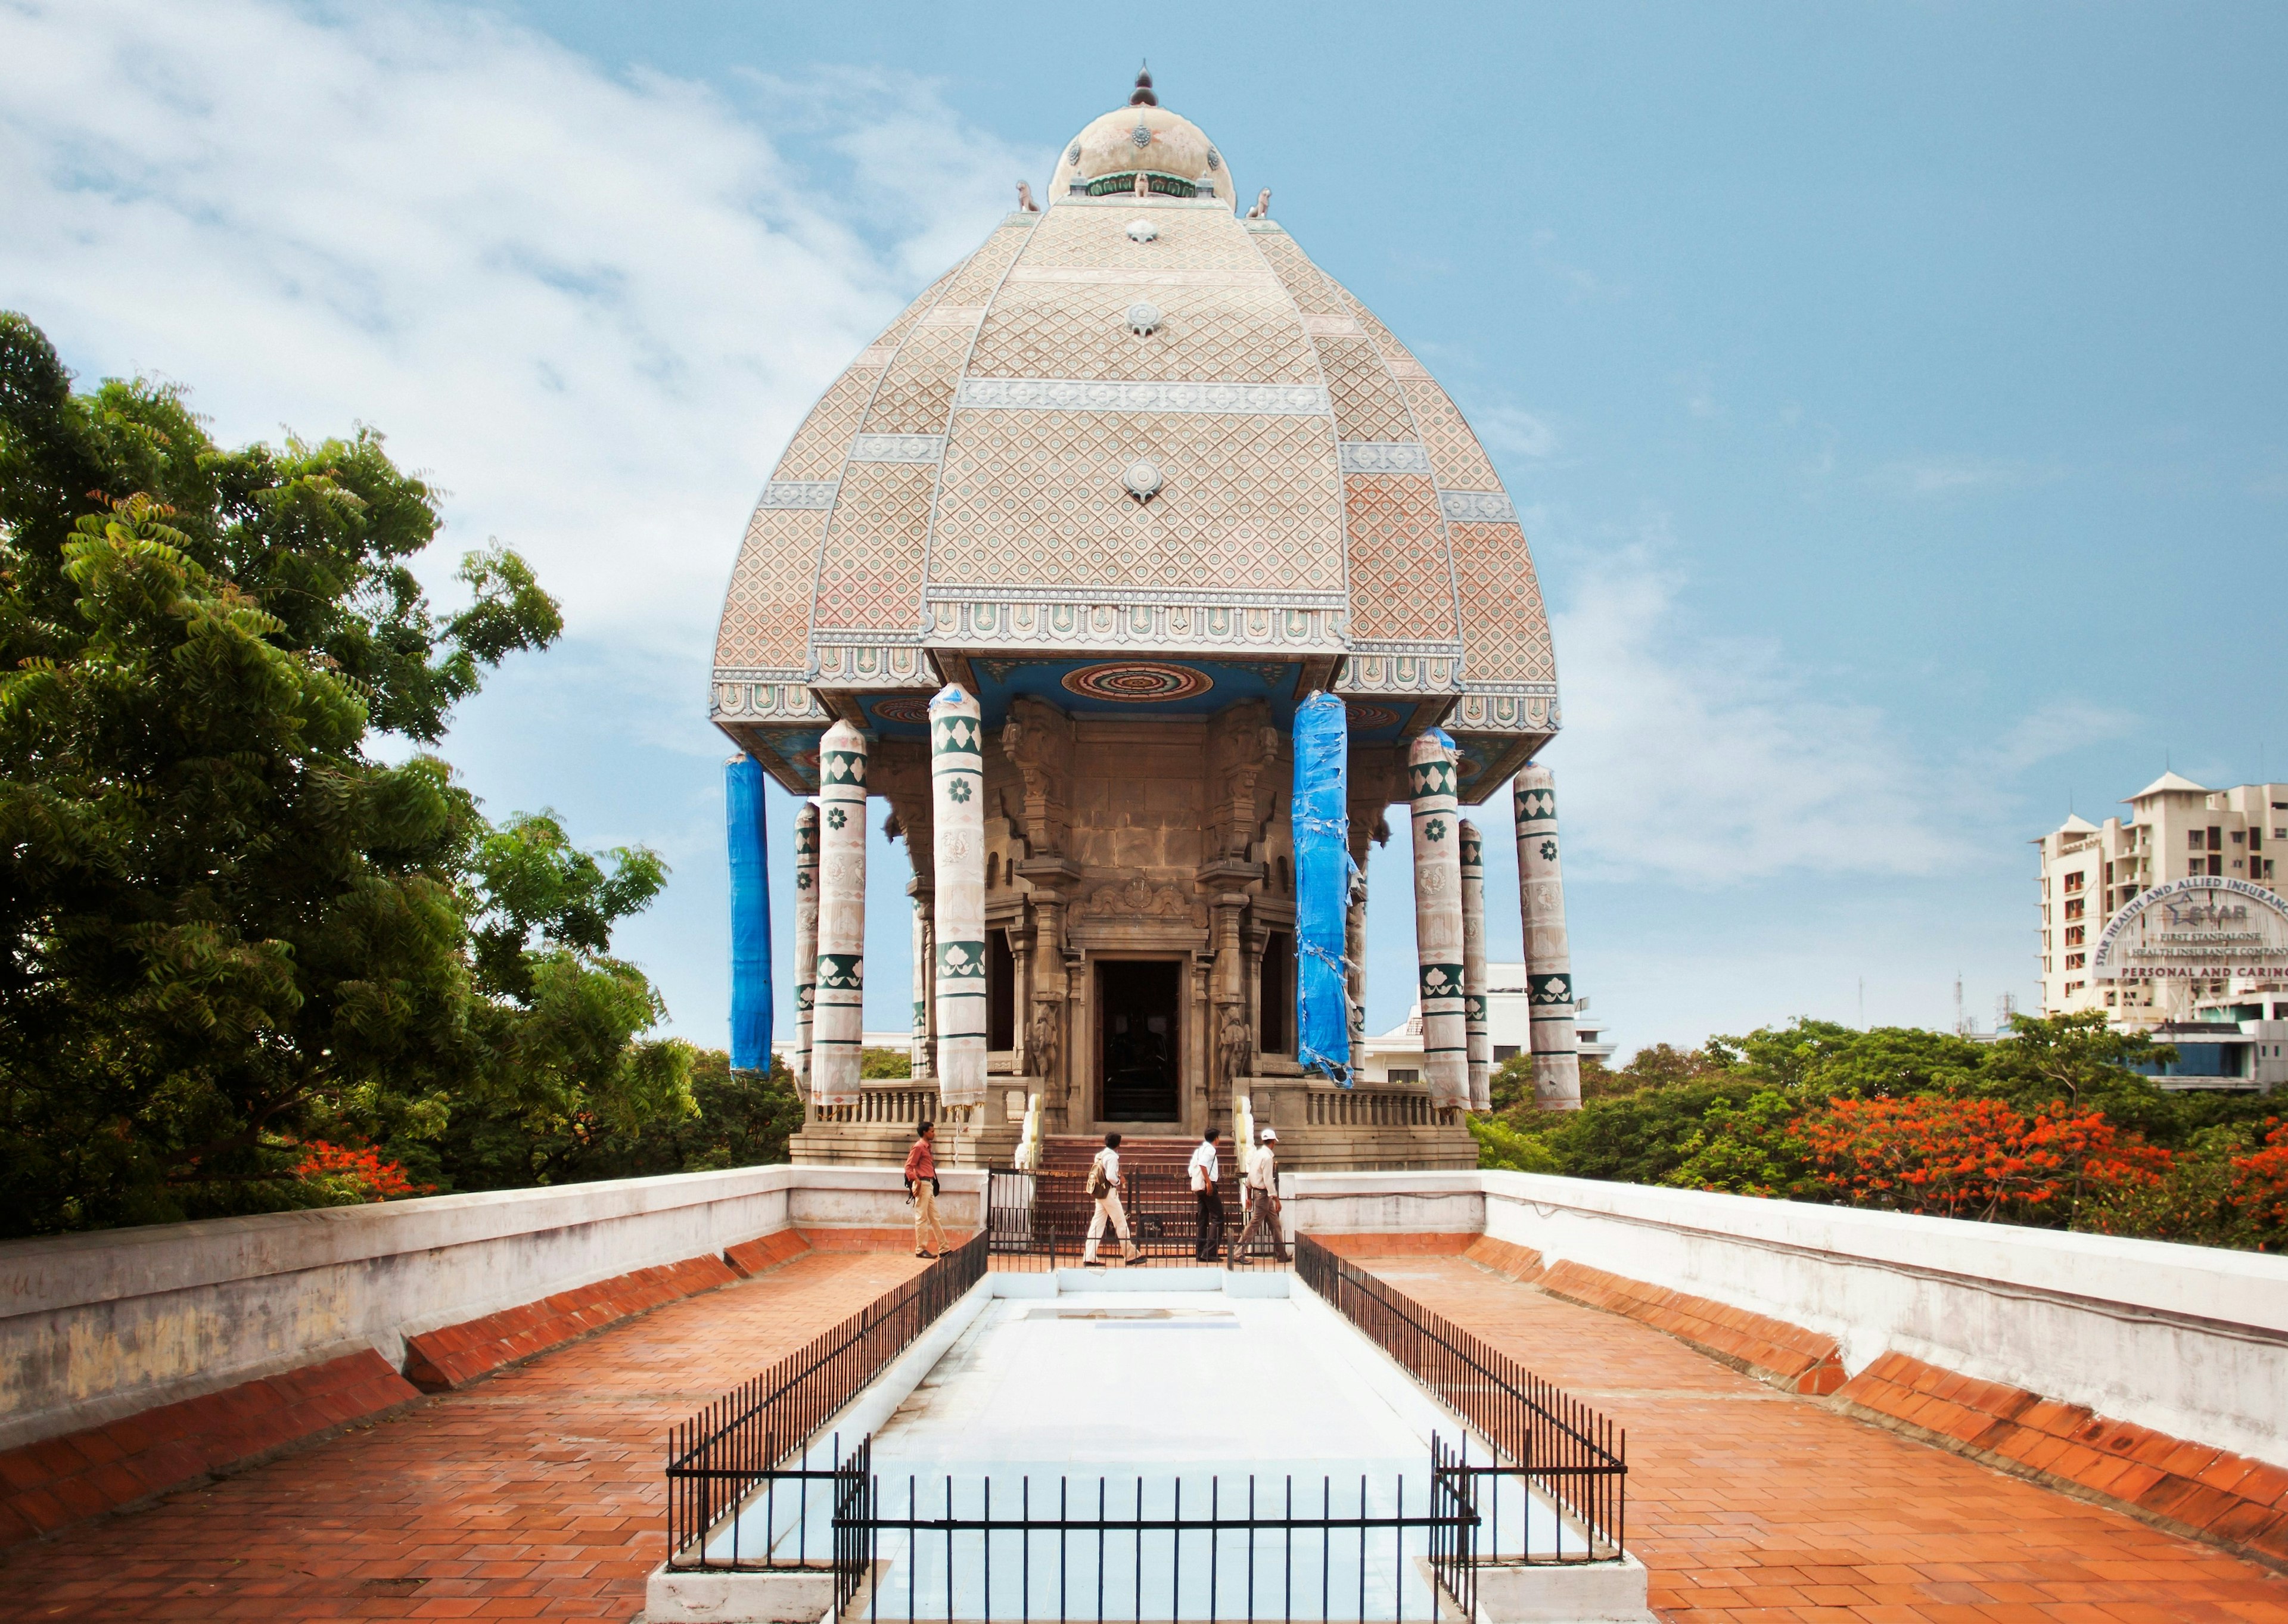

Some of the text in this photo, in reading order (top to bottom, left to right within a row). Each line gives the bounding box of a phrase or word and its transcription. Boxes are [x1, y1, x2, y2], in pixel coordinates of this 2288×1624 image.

[2189, 906, 2247, 919] STAR
[2096, 940, 2111, 966] STAR
[2107, 900, 2143, 938] HEALTH
[2146, 885, 2172, 903] AND
[2178, 878, 2222, 890] ALLIED
[2132, 947, 2174, 956] HEALTH
[2177, 947, 2237, 956] INSURANCE
[2122, 967, 2194, 977] PERSONAL
[2201, 967, 2231, 977] AND
